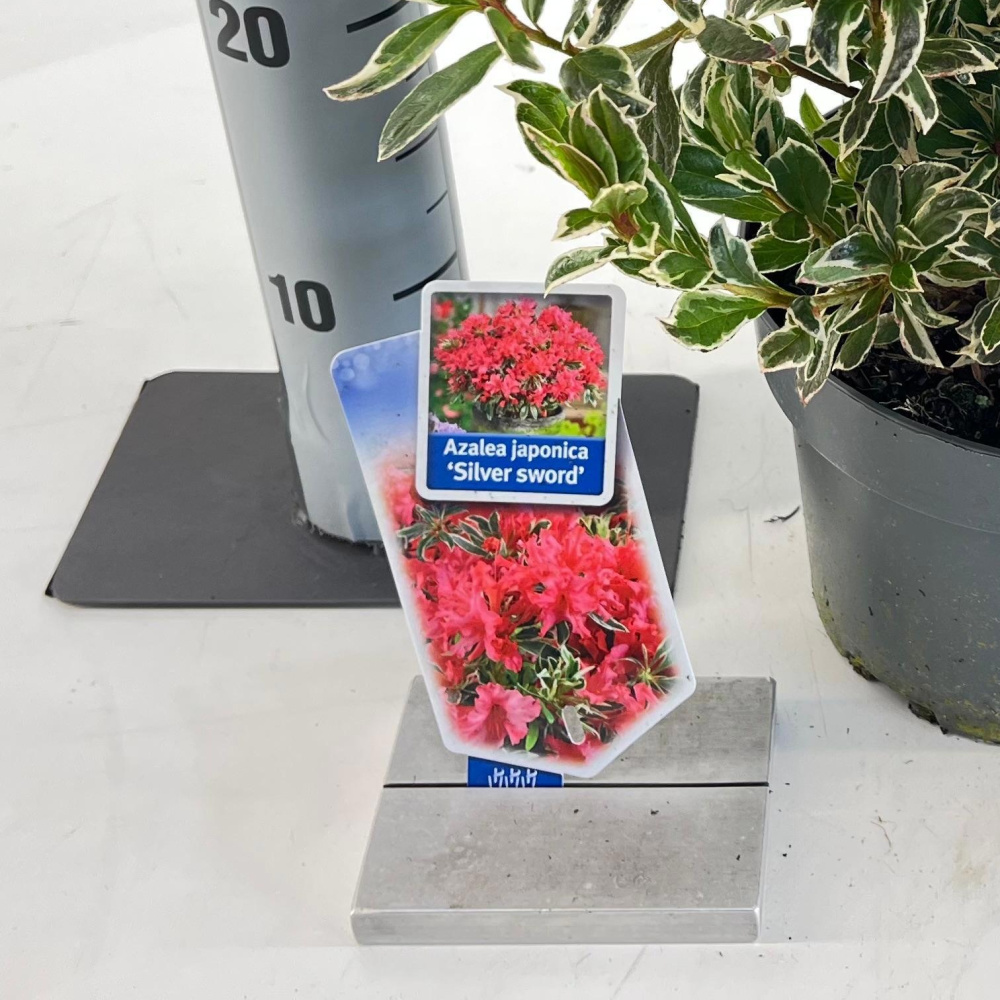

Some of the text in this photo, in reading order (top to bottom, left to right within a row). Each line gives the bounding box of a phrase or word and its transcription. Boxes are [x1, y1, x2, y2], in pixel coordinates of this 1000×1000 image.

[268, 273, 336, 333] 10
[443, 438, 589, 461] Azalea japonica
[447, 461, 585, 485] ‘Silver sword’
